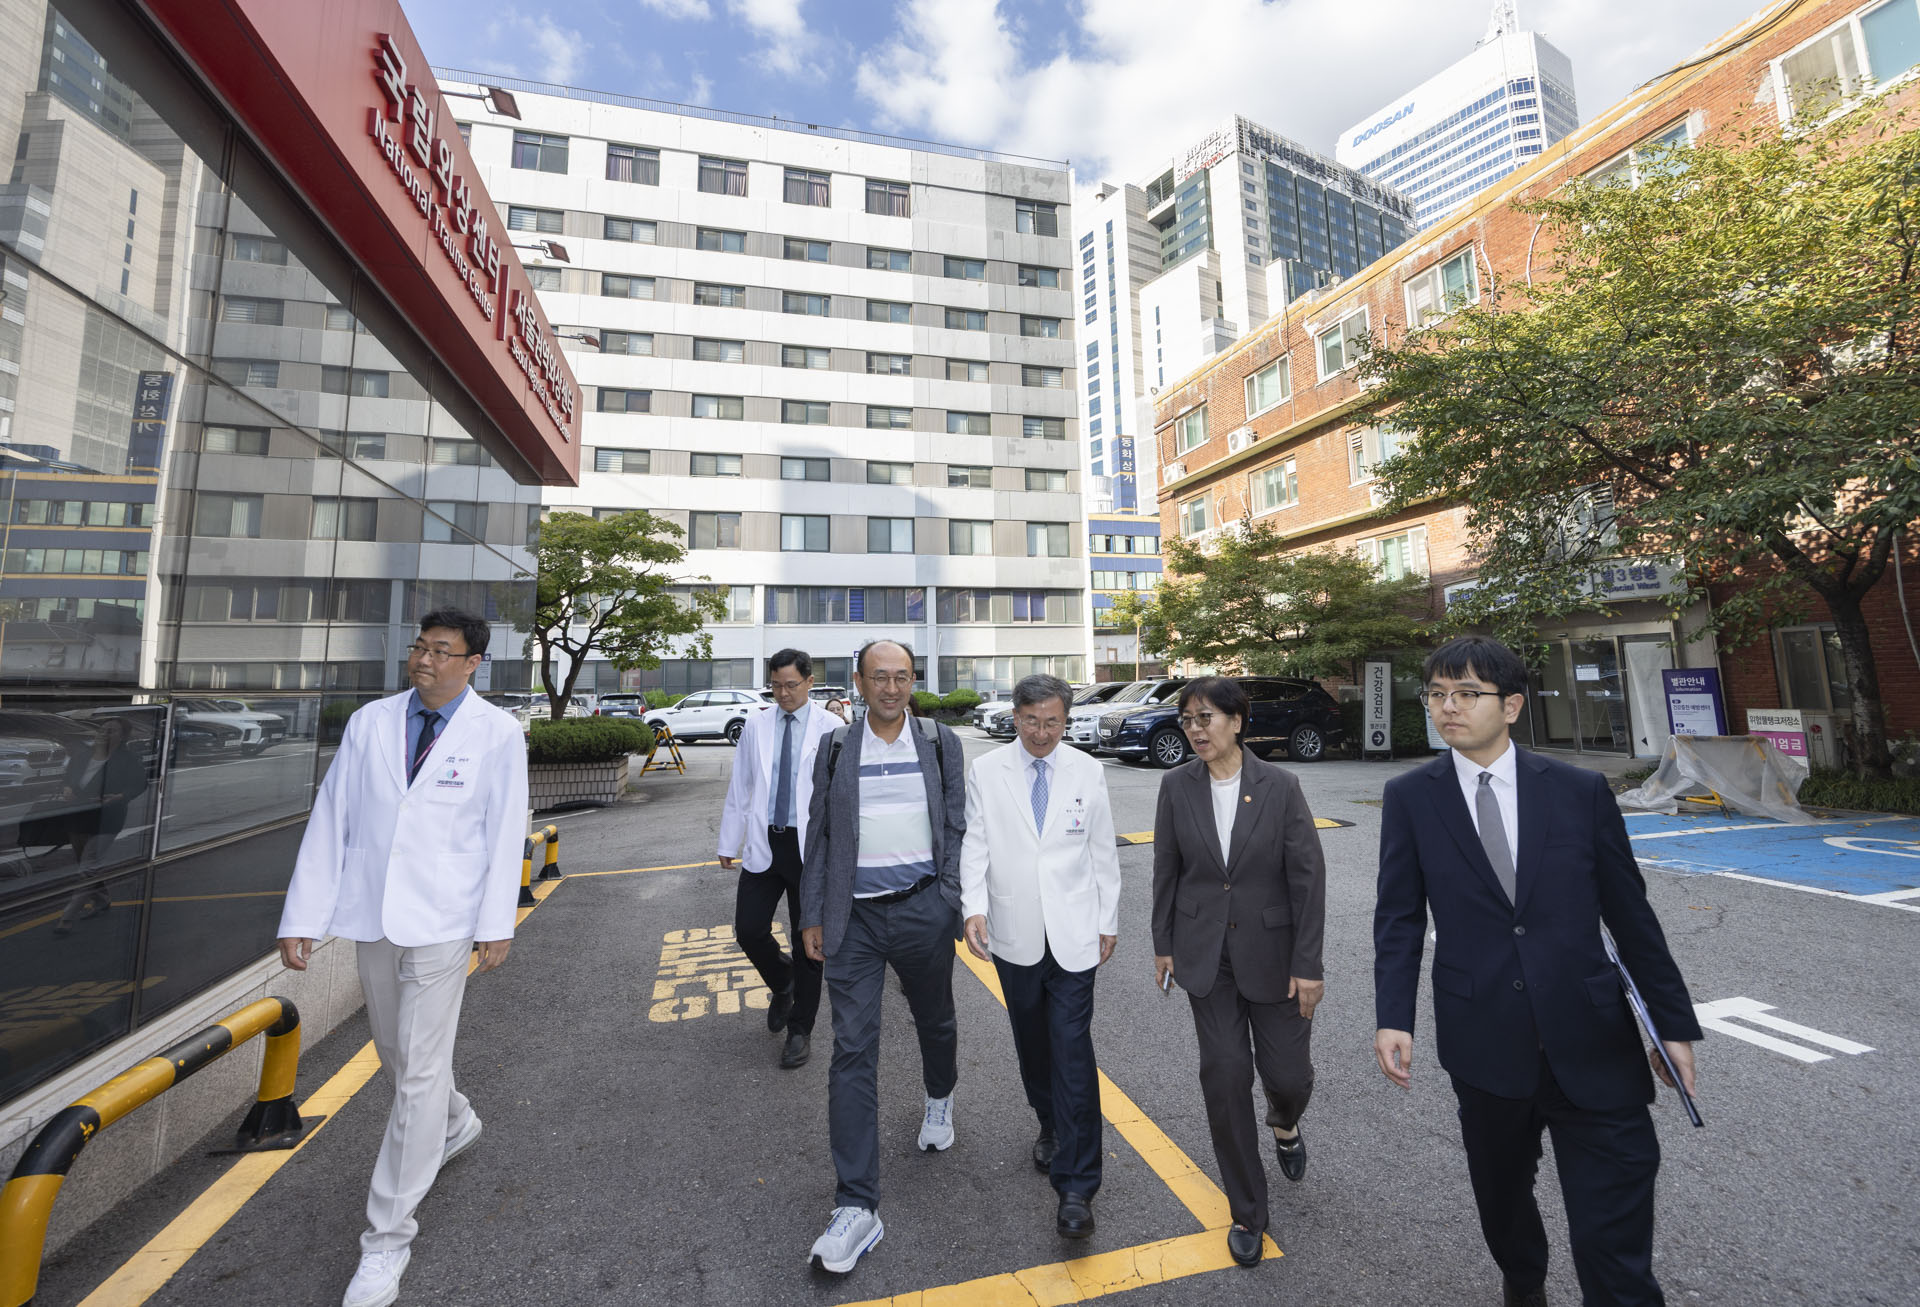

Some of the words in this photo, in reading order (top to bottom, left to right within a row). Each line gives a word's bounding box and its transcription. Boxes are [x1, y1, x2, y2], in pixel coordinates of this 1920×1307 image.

[1352, 102, 1416, 148] DOOSAN
[370, 107, 432, 220] National
[433, 204, 468, 278] Trauma
[468, 268, 495, 322] Center
[510, 336, 528, 373] Seoul
[514, 290, 574, 424] 서울권역외상센터
[1121, 437, 1134, 484] 동화상가
[1373, 666, 1384, 719] 건강검진
[1671, 677, 1705, 686] 별관안내
